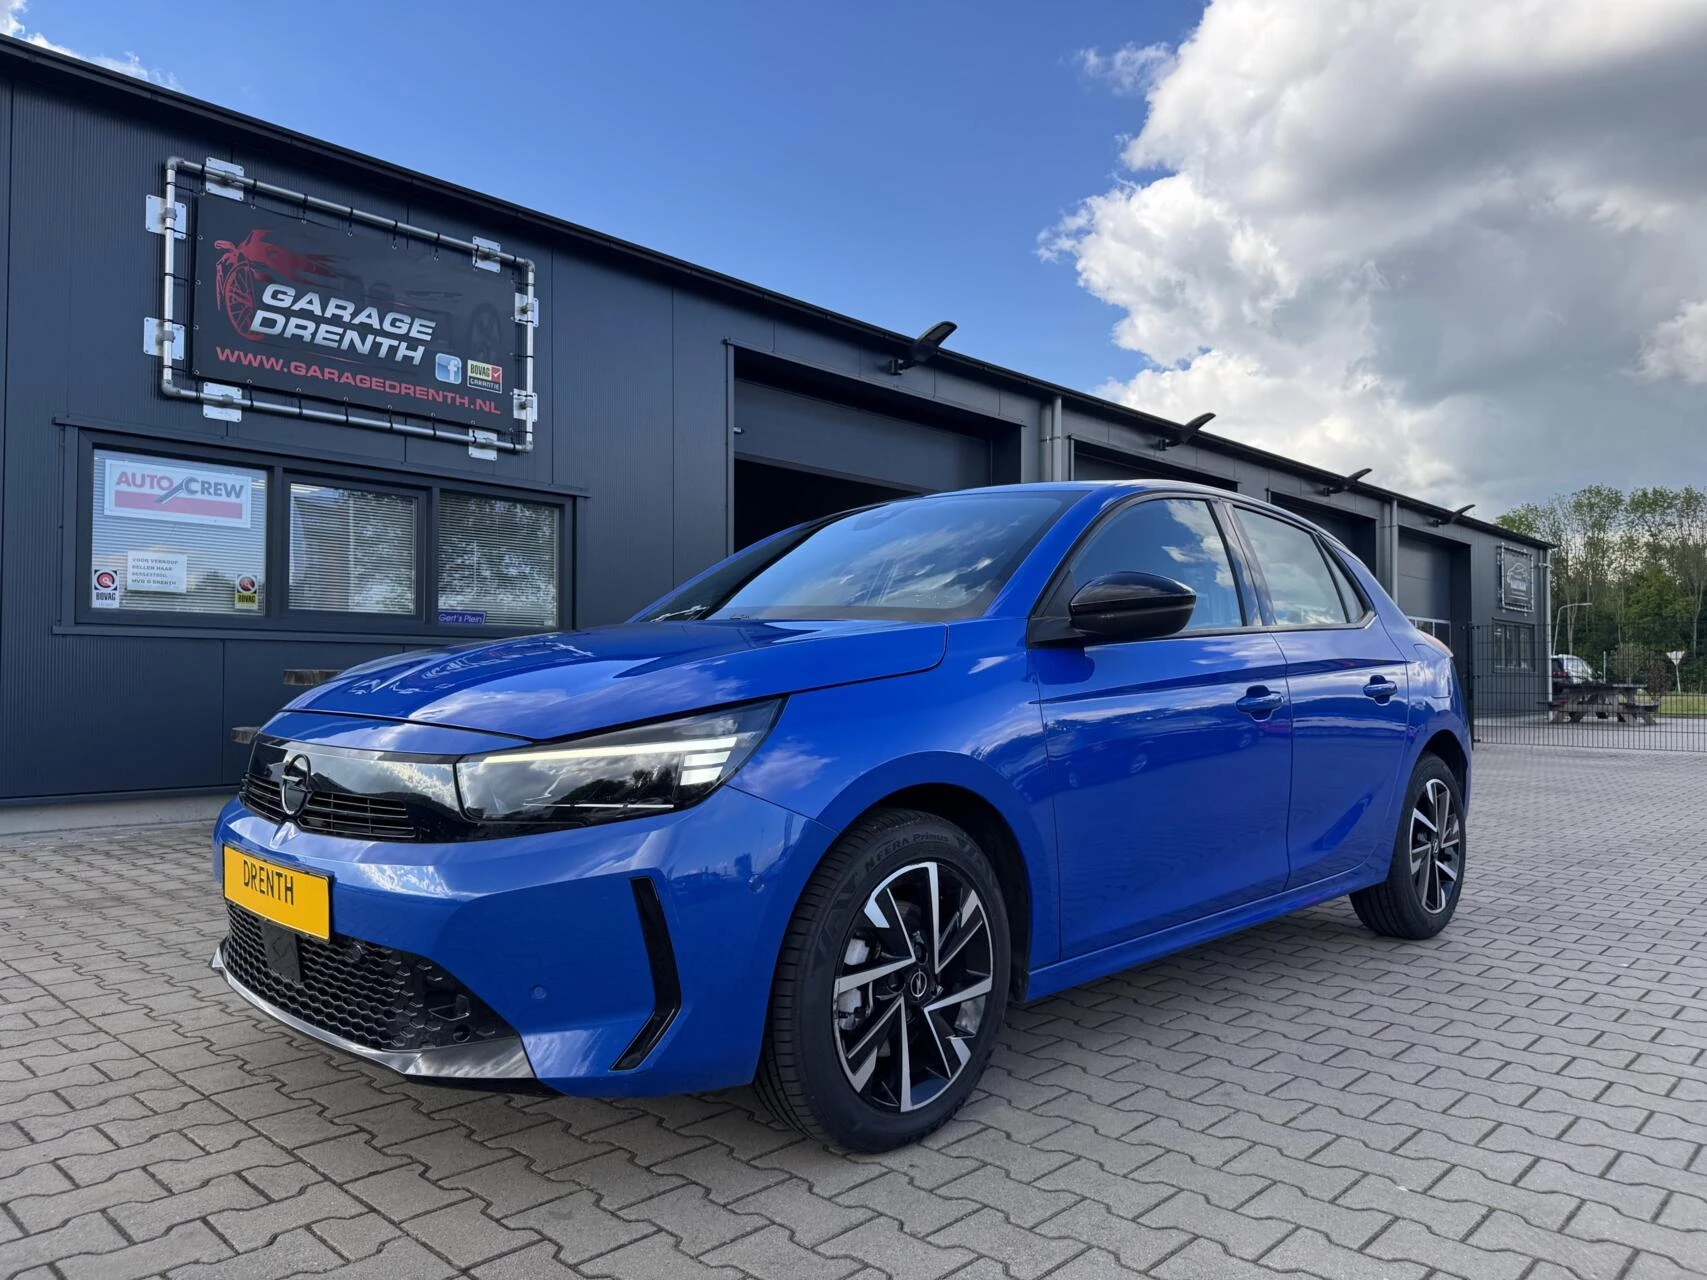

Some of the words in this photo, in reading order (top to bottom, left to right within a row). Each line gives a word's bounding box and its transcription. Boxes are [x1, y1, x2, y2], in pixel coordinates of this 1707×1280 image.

[262, 283, 436, 341] GARAGE
[250, 309, 425, 366] DRENTH
[216, 346, 502, 415] WWW.GARAGEDRENTH.NL
[470, 364, 490, 378] BOVAG
[115, 471, 174, 491] AUTO
[184, 476, 244, 499] CREW
[96, 592, 116, 601] BOVAG
[243, 860, 294, 906] DRENTH
